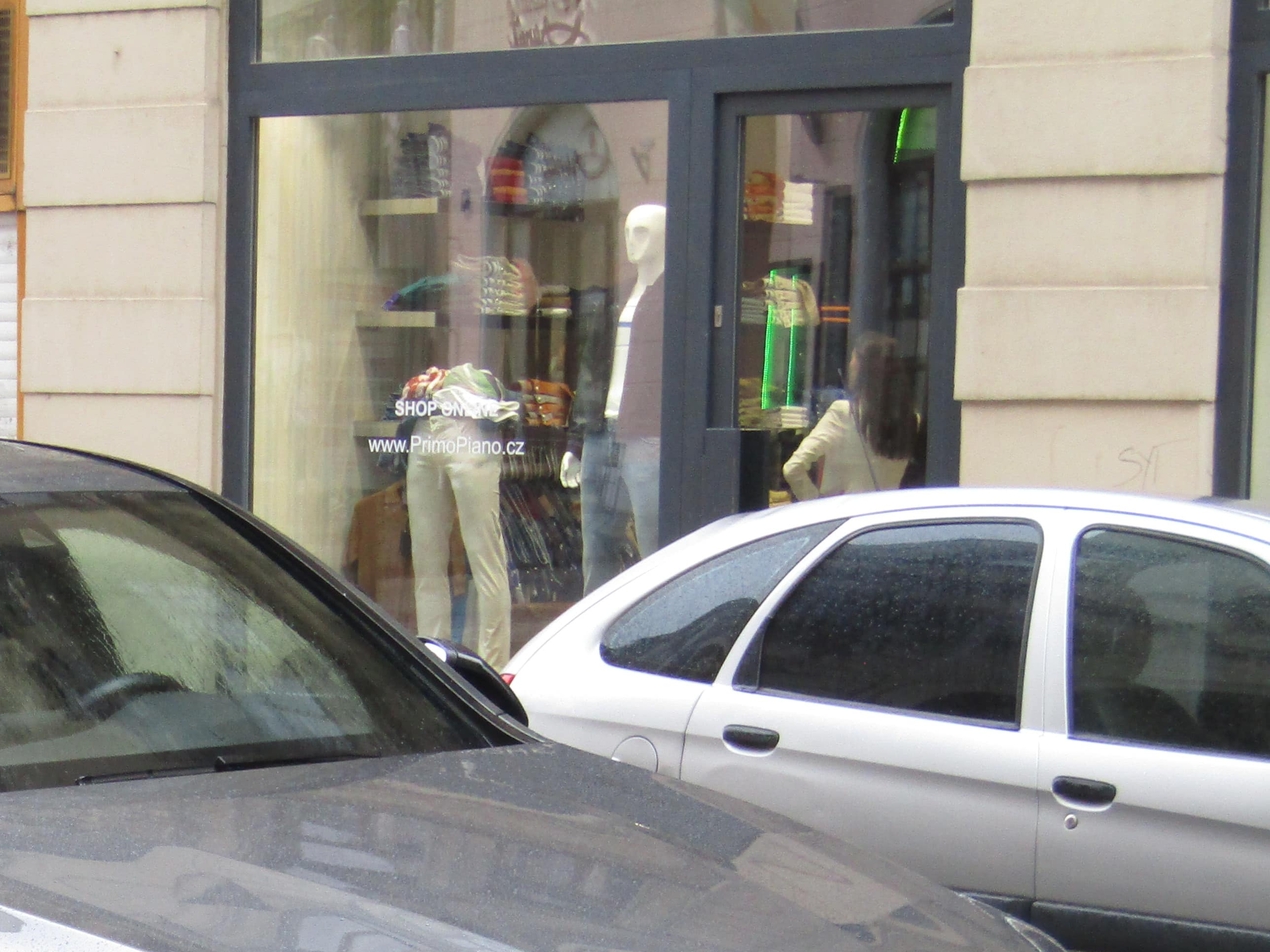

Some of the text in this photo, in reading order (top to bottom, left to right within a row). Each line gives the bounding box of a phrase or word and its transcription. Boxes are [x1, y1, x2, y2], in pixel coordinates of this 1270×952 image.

[394, 400, 499, 417] SHOP ONNE
[368, 435, 525, 456] www.PrimoPiano.cz
